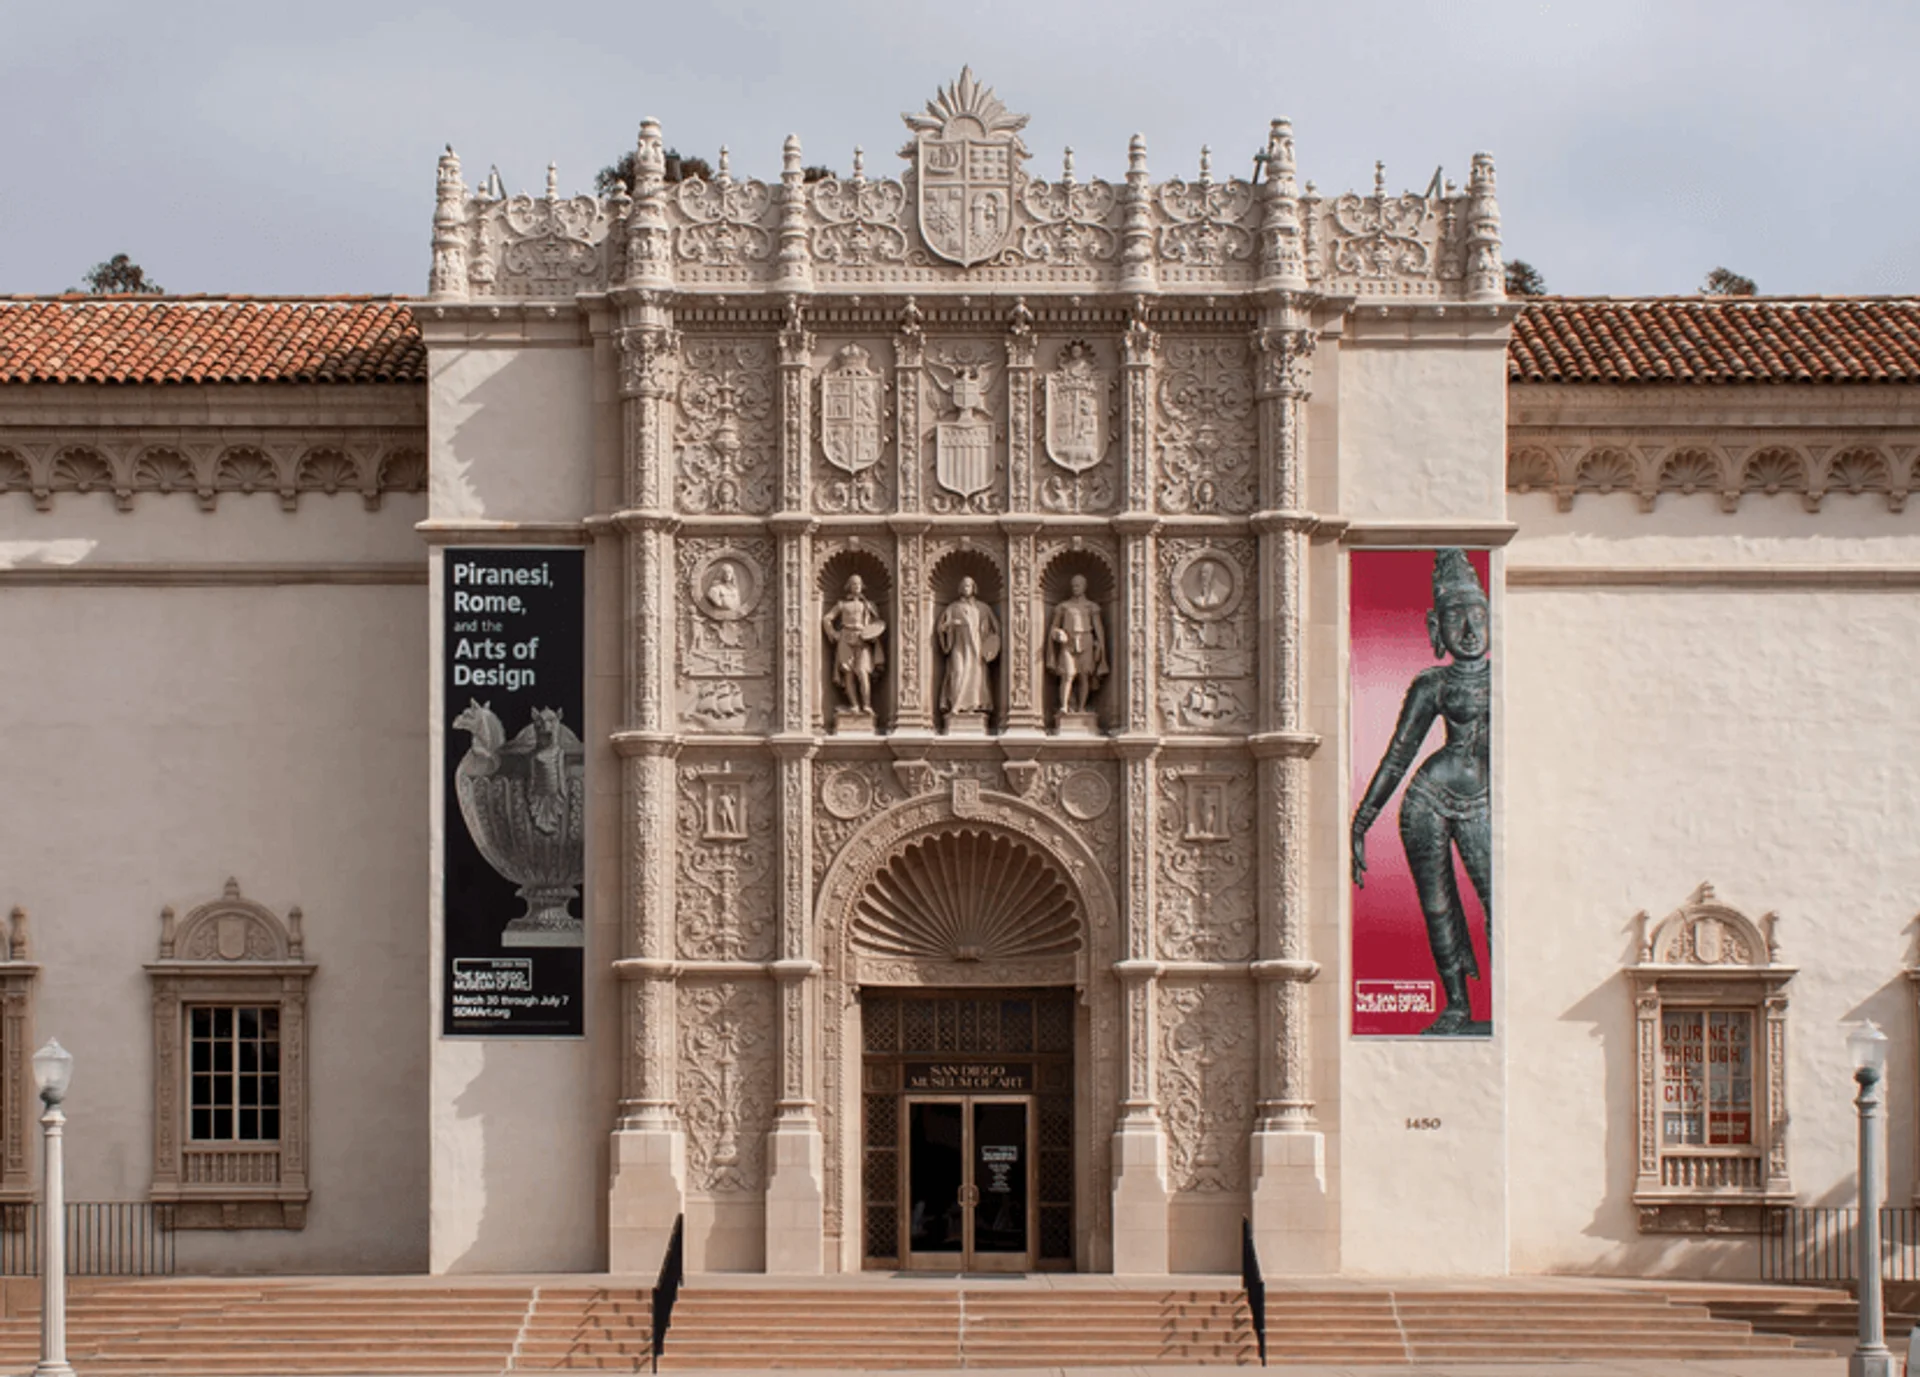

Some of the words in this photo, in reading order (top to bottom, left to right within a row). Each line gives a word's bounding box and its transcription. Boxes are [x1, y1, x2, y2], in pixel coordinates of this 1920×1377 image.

[454, 561, 554, 588] Piranesi,
[454, 591, 527, 615] Rome,
[454, 619, 477, 632] and
[481, 619, 503, 632] the
[454, 638, 507, 659] Arts
[512, 637, 539, 659] of
[454, 663, 536, 692] Design
[453, 995, 485, 1005] March
[487, 995, 499, 1005] 30
[501, 995, 539, 1008] through
[540, 995, 560, 1008] July
[562, 995, 570, 1005] 7
[452, 1006, 512, 1019] SDMArt.org
[1663, 1046, 1741, 1063] THROUGH
[930, 1065, 959, 1075] SAN
[961, 1065, 1006, 1075] DIEGO
[1664, 1065, 1692, 1081] THE
[911, 1076, 972, 1088] MUSEUM
[973, 1076, 991, 1088] OF
[998, 1076, 1025, 1088] ART
[1664, 1085, 1700, 1103] CITY
[1404, 1117, 1442, 1131] 1450
[1666, 1120, 1699, 1136] FREE
